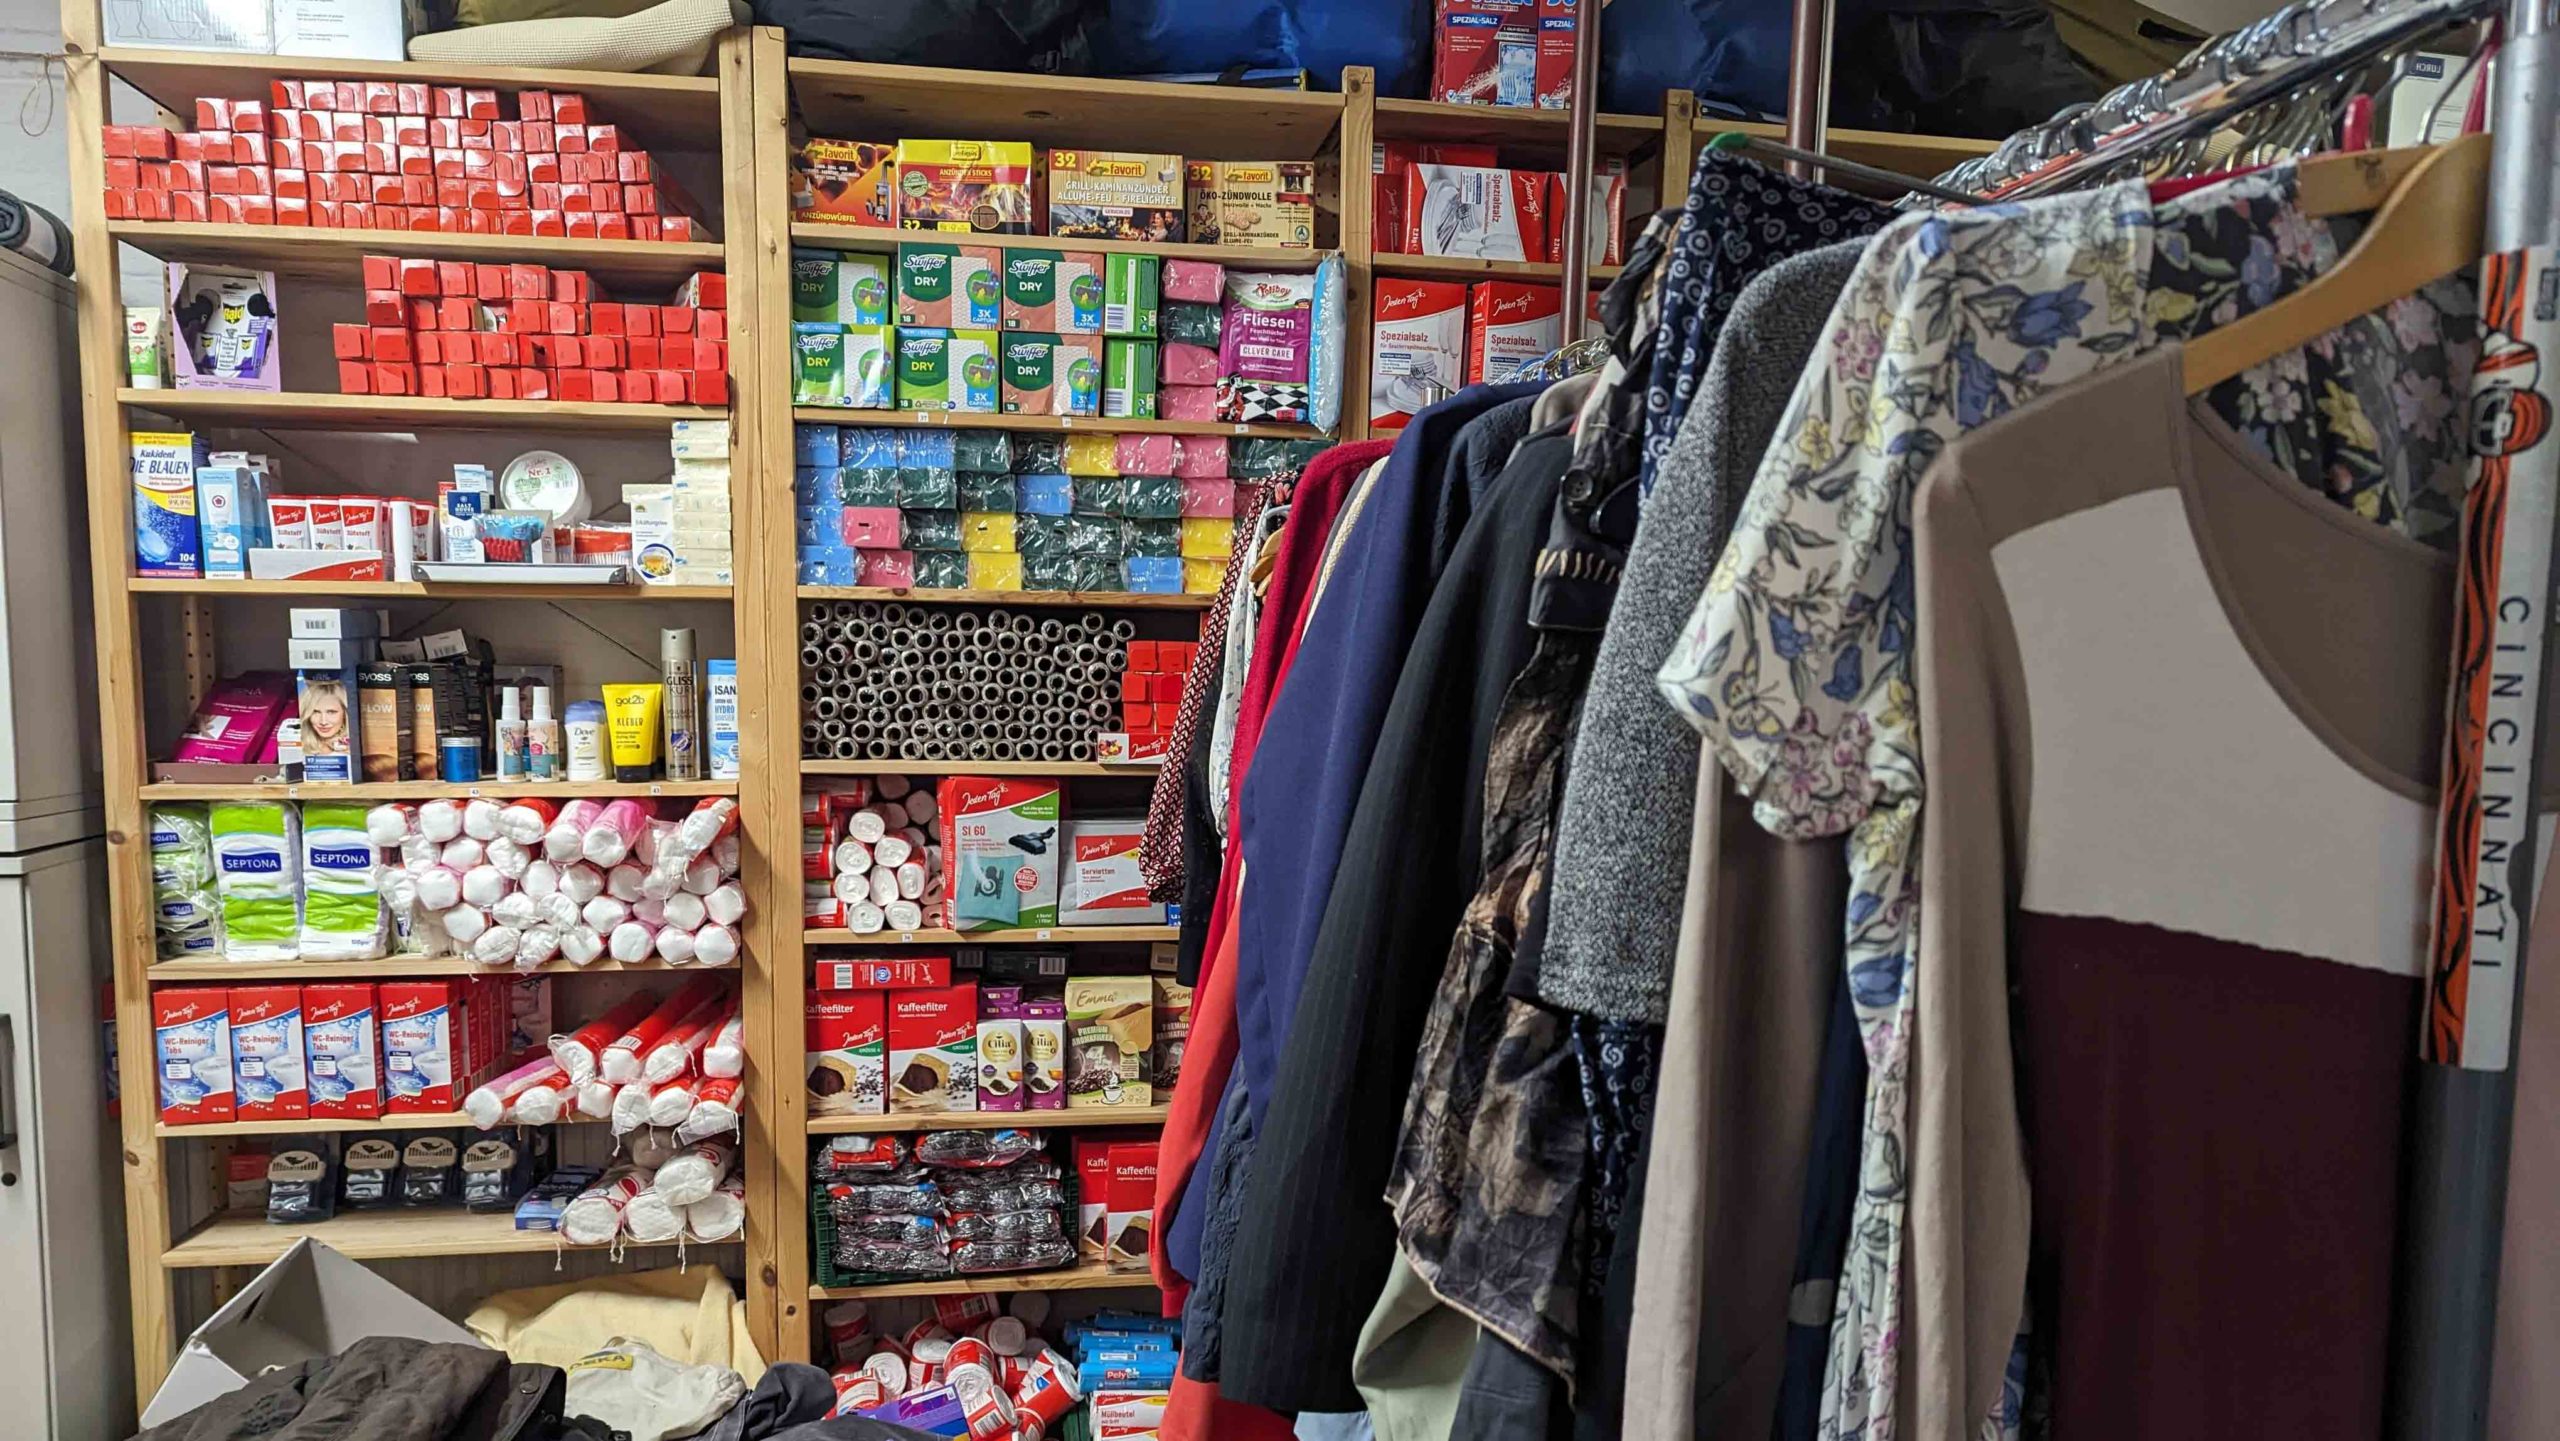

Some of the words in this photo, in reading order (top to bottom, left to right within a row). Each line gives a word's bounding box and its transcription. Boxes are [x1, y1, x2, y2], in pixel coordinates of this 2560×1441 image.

[1452, 16, 1498, 25] SPEZIAL-SALZ
[824, 147, 855, 160] favorit
[1054, 152, 1077, 168] 32
[971, 169, 993, 178] STICKS
[1109, 163, 1142, 177] favorit
[1190, 166, 1212, 181] 32
[1242, 170, 1269, 182] favorit
[1065, 180, 1169, 194] GRILL-KAMINANZÜNDER
[1057, 191, 1112, 203] ALLUME-FEU
[1121, 193, 1178, 205] FIRELIGHTER
[1200, 190, 1272, 201] ÖKO-ZÜNDWOLLE
[1491, 173, 1503, 223] Spezialsalz
[801, 211, 857, 223] ANZÜNDWÜRFEL
[792, 260, 833, 277] Swiffer
[904, 254, 947, 272] Swiffer
[1009, 260, 1050, 276] Swiffer
[914, 276, 938, 287] DRY
[1019, 281, 1043, 291] DRY
[801, 283, 825, 292] DRY
[1382, 293, 1406, 313] Jeden
[1406, 291, 1421, 309] Tag
[1493, 298, 1516, 316] Jeden
[1516, 296, 1528, 313] Tag
[224, 307, 243, 320] Raid
[978, 309, 991, 318] 3X
[1081, 314, 1094, 323] 3X
[863, 316, 877, 324] 3X
[1242, 313, 1295, 329] Fliesen
[1381, 330, 1429, 343] Spezialsalz
[1491, 334, 1537, 347] Spezialsalz
[797, 335, 838, 352] Swiffer
[901, 339, 944, 356] Swiffer
[1007, 343, 1048, 360] Swiffer
[1242, 345, 1270, 357] CLEVER
[1271, 348, 1291, 359] CARE
[806, 357, 831, 367] DRY
[911, 361, 935, 371] DRY
[1017, 366, 1041, 376] DRY
[974, 392, 988, 401] 3X
[140, 449, 176, 459] Kukident
[149, 460, 190, 475] BLAUEN
[179, 554, 195, 562] 104
[358, 672, 392, 684] syoss
[666, 675, 693, 685] GLISS
[615, 695, 646, 707] got2b
[714, 705, 735, 714] HYDRO
[616, 717, 644, 727] KLEBER
[574, 727, 596, 736] Dove
[2470, 595, 2530, 969] CINCINNATI
[962, 792, 987, 812] Jeden
[987, 788, 1002, 807] Tag
[962, 826, 971, 836] SI
[973, 825, 986, 836] 60
[226, 857, 279, 870] SEPTONA
[314, 853, 368, 865] SEPTONA
[1081, 867, 1116, 876] Servietten
[1076, 989, 1114, 1007] Emma
[806, 1004, 854, 1013] Kaffeefilter
[898, 1002, 948, 1012] Kaffeefilter
[388, 1030, 431, 1039] WC-Reiniger
[1077, 1026, 1109, 1036] PREMIUM
[164, 1037, 209, 1046] WC-Reiniger
[238, 1035, 282, 1043] WC-Reiniger
[389, 1039, 405, 1047] Tabs
[987, 1039, 1011, 1049] Cilia
[1030, 1038, 1053, 1047] Cilia
[1086, 1046, 1105, 1066] 4
[1106, 1370, 1127, 1380] Pely
[1101, 1409, 1135, 1418] Müllbeutel
